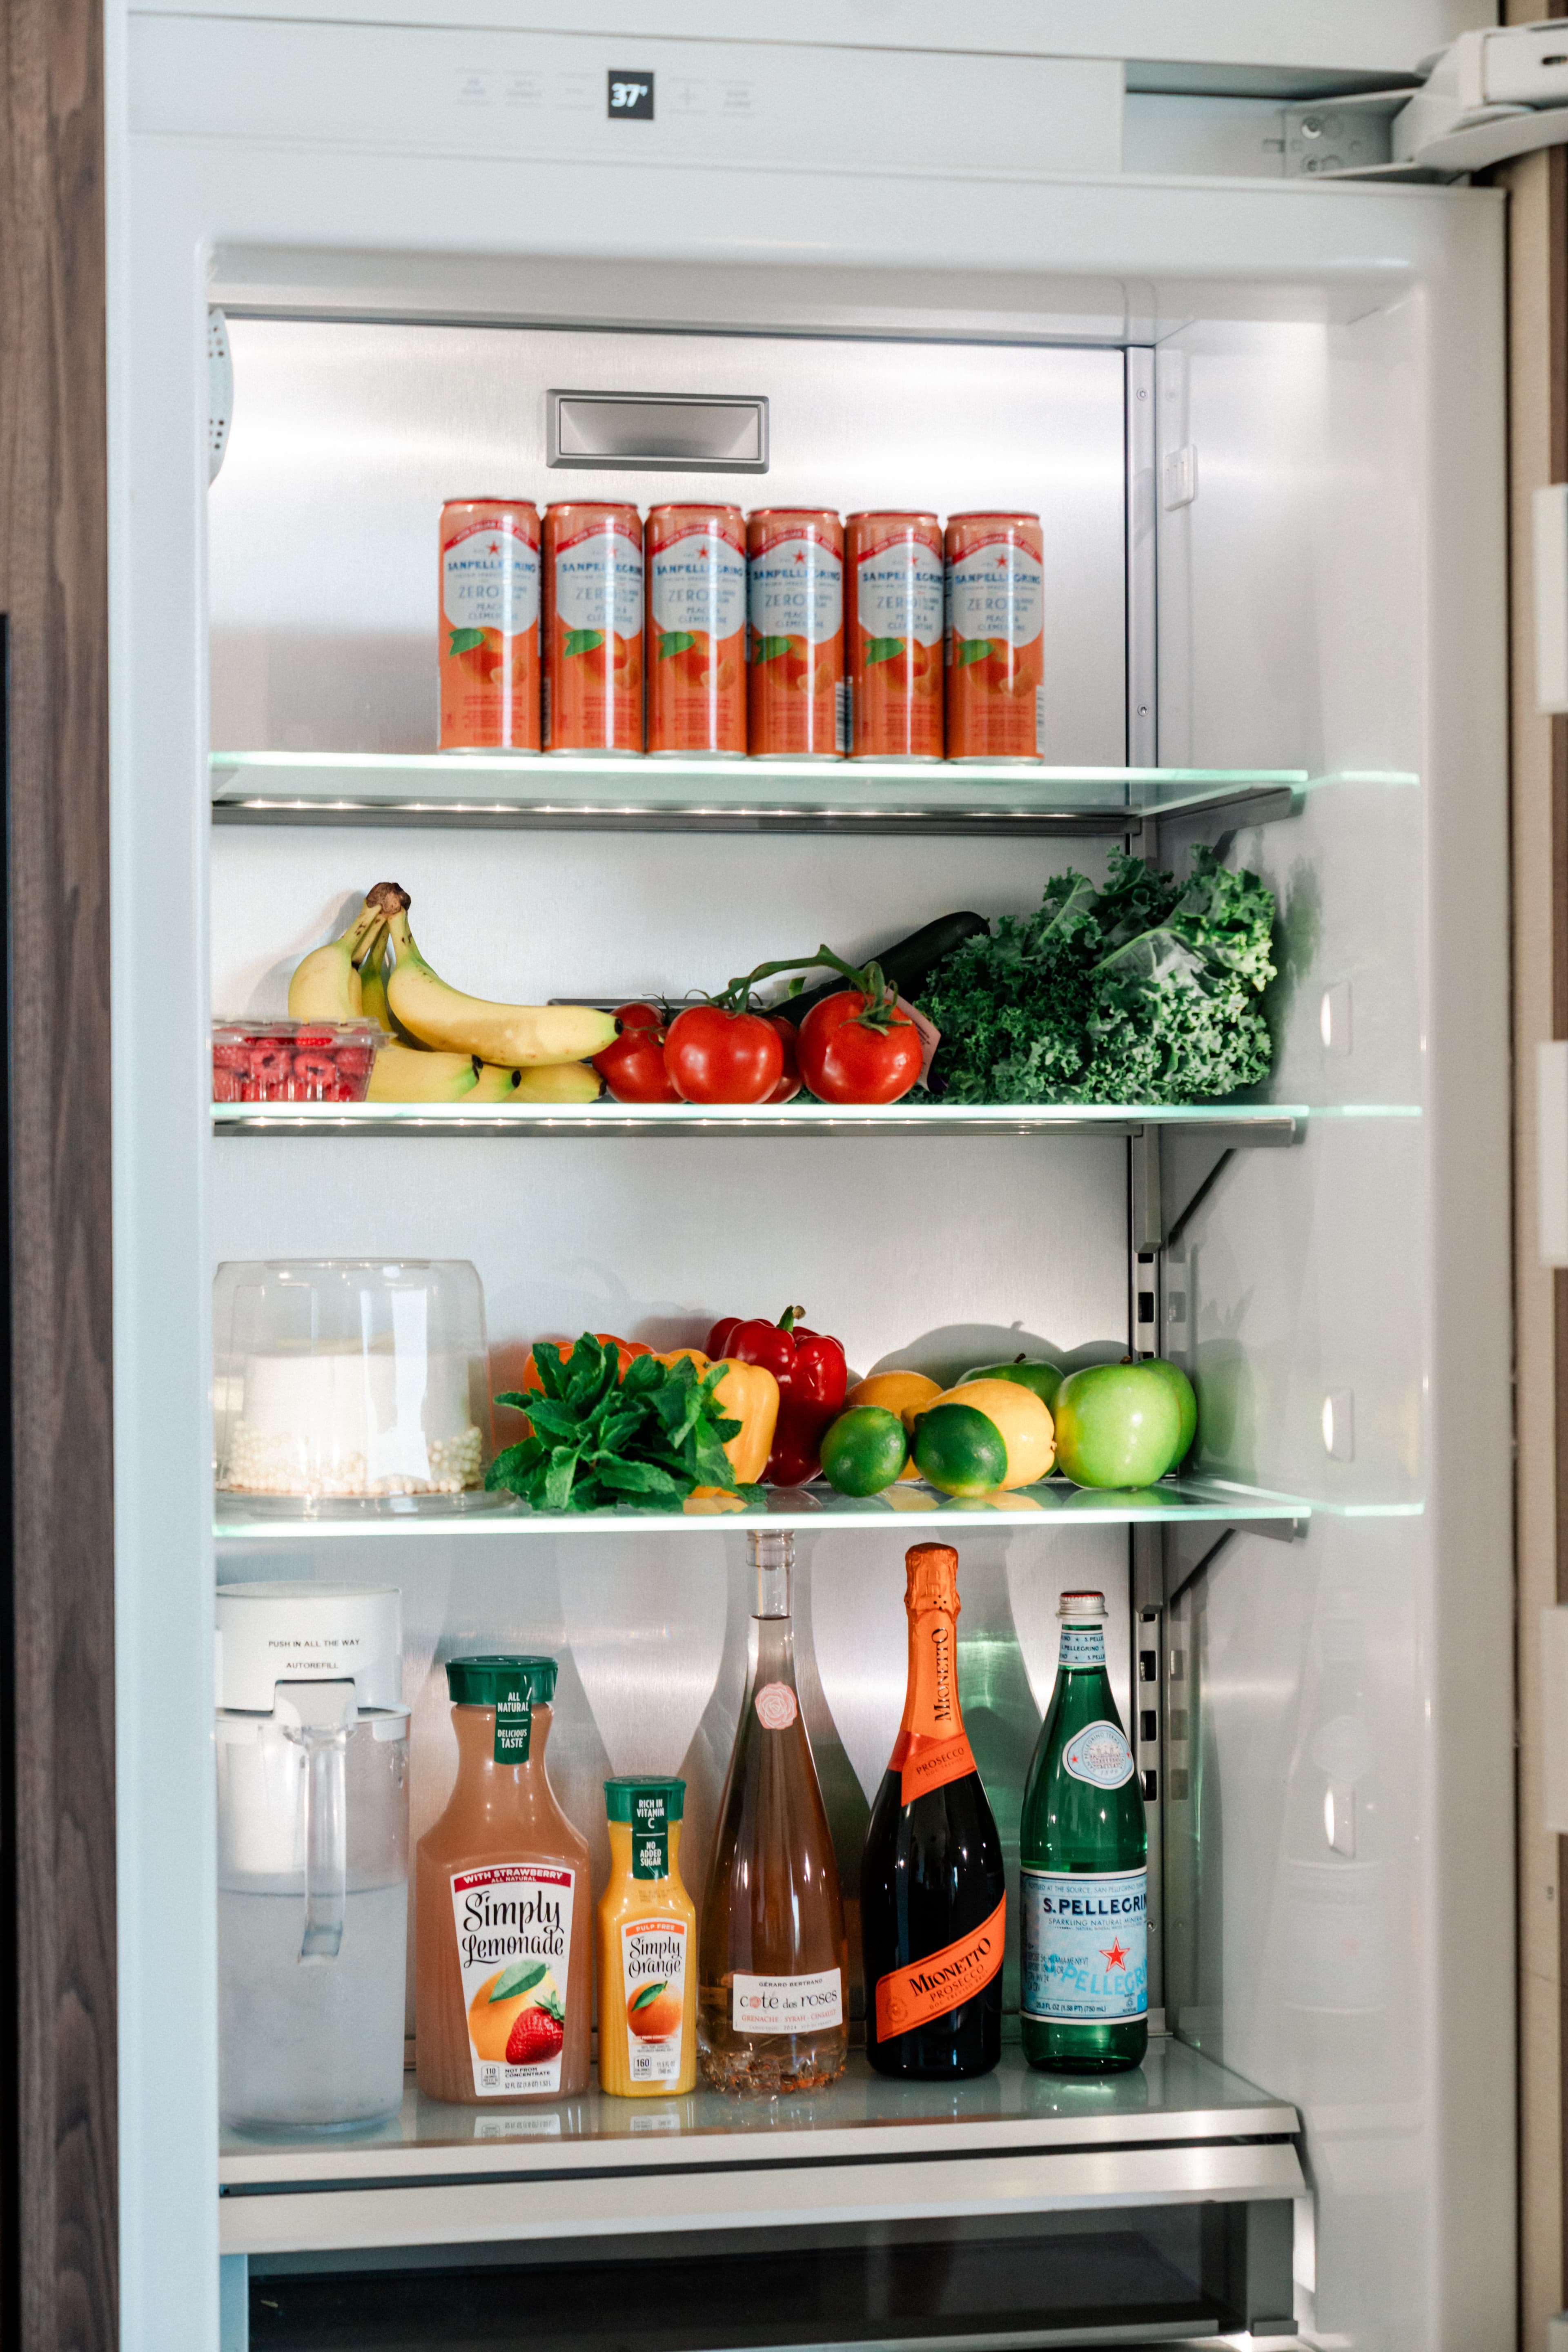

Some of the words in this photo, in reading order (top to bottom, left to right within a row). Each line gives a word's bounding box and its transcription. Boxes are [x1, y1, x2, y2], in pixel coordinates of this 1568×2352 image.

[459, 585, 499, 599] ZERO
[576, 587, 617, 601] ZER
[668, 589, 709, 603] ZERO
[765, 594, 805, 608] ZERO
[967, 597, 1007, 611] ZERO
[508, 1692, 520, 1702] ALL
[498, 1702, 529, 1713] NATURAL
[498, 1729, 527, 1738] DELICIOUS
[501, 1738, 523, 1748] TASTE
[916, 1747, 964, 1774] PROSECCO
[639, 1799, 655, 1808] RICH
[656, 1799, 663, 1807] IN
[637, 1808, 665, 1817] VITAMIN
[648, 1817, 655, 1829] C
[646, 1841, 656, 1850] NO
[640, 1849, 662, 1858] ADDED
[640, 1858, 661, 1866] SUGAR
[464, 1872, 491, 1884] WITH
[494, 1868, 563, 1880] STRAWBERRY
[463, 1890, 564, 1934] Simply
[636, 1924, 655, 1932] PULP
[1049, 1918, 1088, 1926] SPARKLING
[462, 1929, 564, 1969] Lemonade
[630, 1936, 682, 1960] Simply
[628, 1958, 682, 1979] Orange
[790, 1978, 823, 1987] BERTRAND
[930, 1964, 984, 2002] PROSECCO
[782, 2000, 797, 2009] des
[801, 1989, 837, 2007] roses
[742, 2014, 778, 2022] GRENACHE
[811, 2009, 836, 2020] CINSAULT
[637, 2058, 650, 2067] 160
